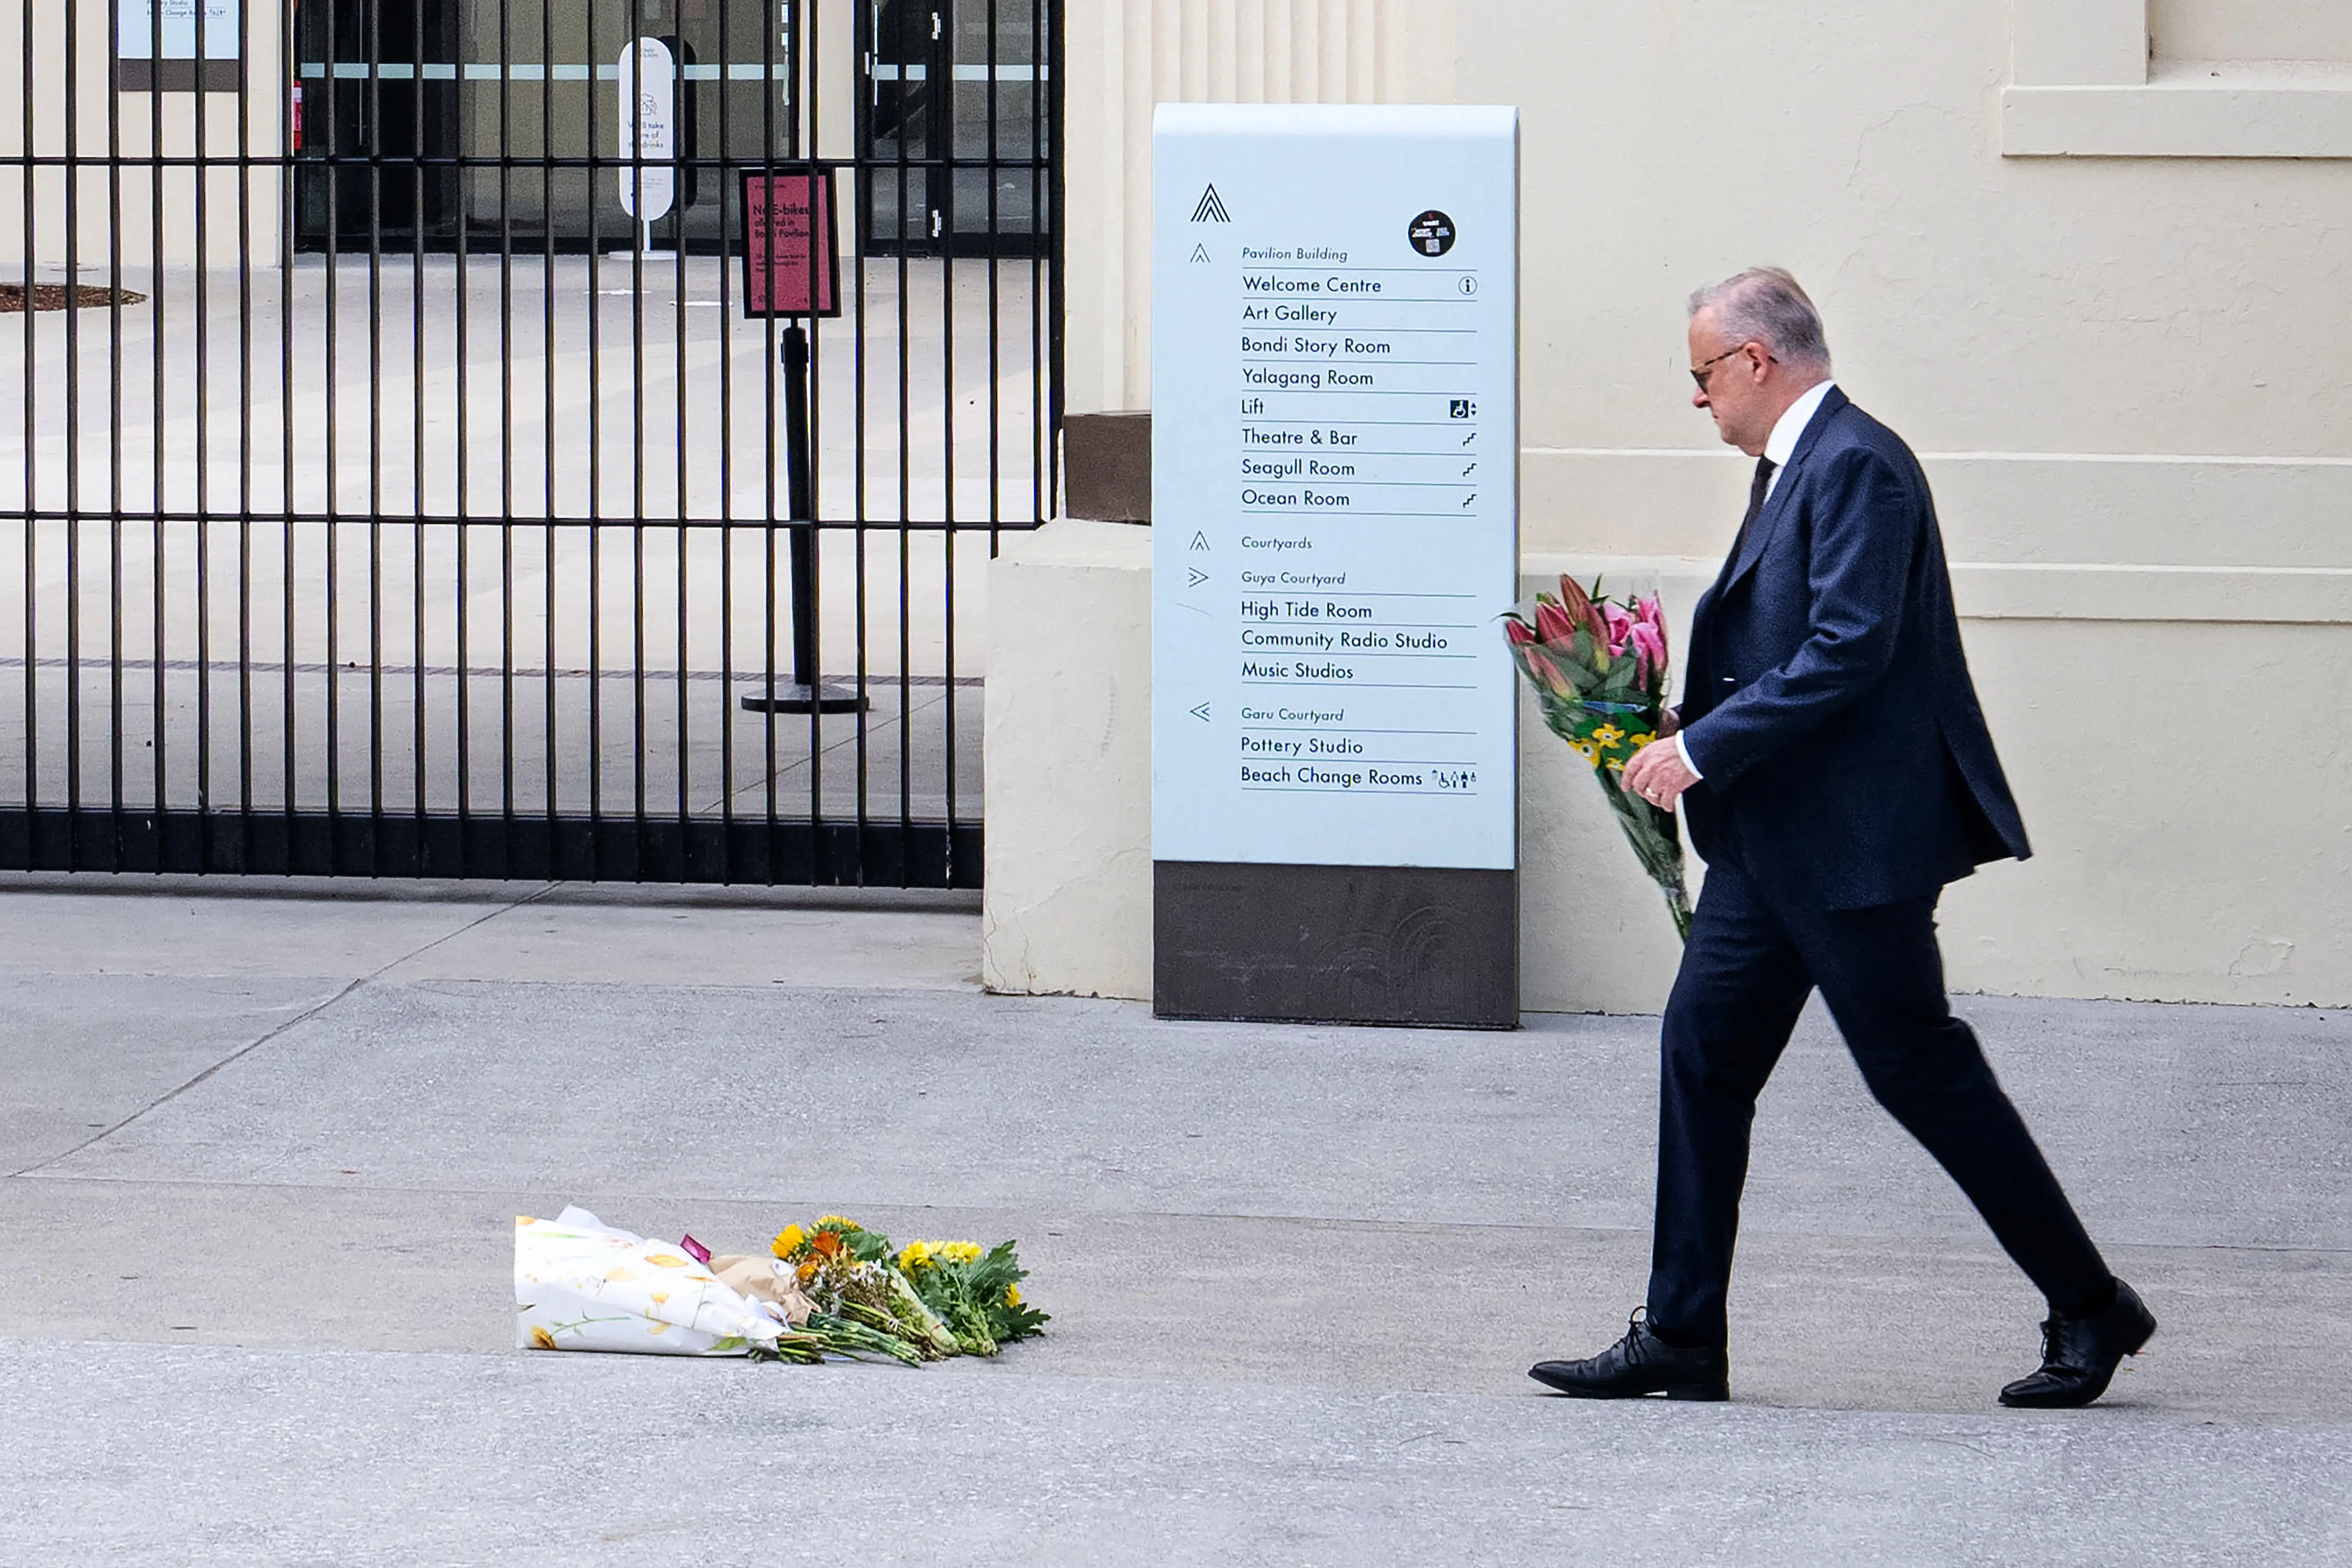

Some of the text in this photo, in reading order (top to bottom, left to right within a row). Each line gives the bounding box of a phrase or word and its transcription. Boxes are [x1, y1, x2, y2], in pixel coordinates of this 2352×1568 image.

[1242, 246, 1347, 263] Pavilion Building
[1243, 275, 1381, 292] Welcome Centre
[1243, 304, 1338, 326] Art Gallery
[1242, 336, 1390, 358] Bondi Story Room
[1243, 367, 1373, 389] Yalagang Room
[1242, 398, 1264, 414] Lift
[1242, 427, 1358, 445] Theatre & Bar
[1242, 458, 1355, 479] Seagull Room
[1241, 489, 1350, 506] Ocean Room
[1242, 536, 1312, 552] Courtyards
[1241, 571, 1346, 588] Guya Courtyard
[1241, 600, 1372, 621] High Tide Room
[1242, 630, 1447, 651] Community Radio Studio
[1242, 661, 1354, 679] Music Studios
[1241, 707, 1344, 724] Garu Courtyard
[1241, 737, 1363, 757] Pottery Studio
[1241, 766, 1422, 788] Beach Change Rooms
